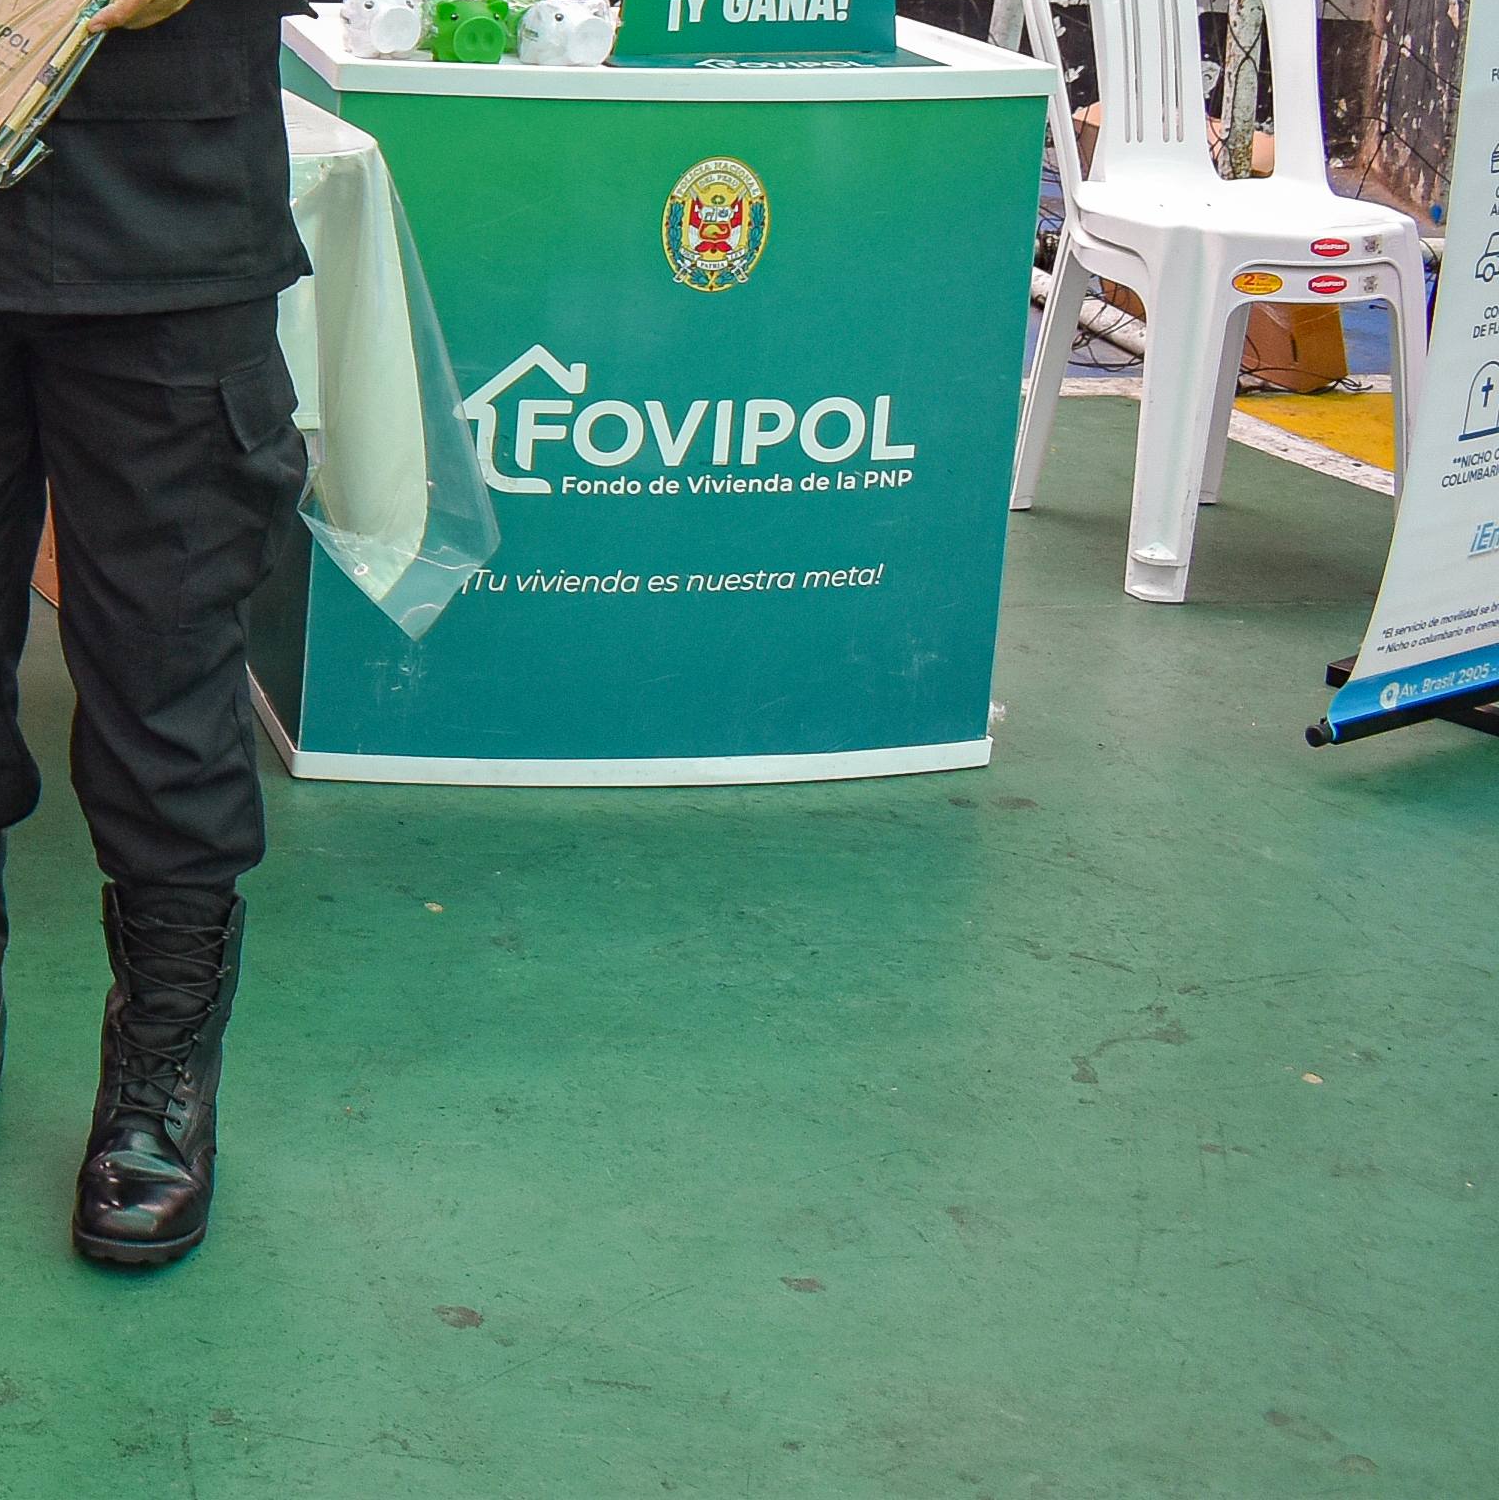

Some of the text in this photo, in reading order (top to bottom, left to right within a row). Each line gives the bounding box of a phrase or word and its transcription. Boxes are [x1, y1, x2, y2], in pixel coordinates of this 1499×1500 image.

[1243, 273, 1255, 287] 2
[1472, 324, 1488, 339] DE
[515, 395, 916, 471] FOVIPOL
[561, 467, 914, 495] Fondo de Vivienda de la PNP
[460, 563, 885, 595] ¡Tu vivienda es nuestra meta!
[1394, 619, 1427, 636] servicio
[1428, 616, 1439, 628] de
[1441, 605, 1480, 625] movilidad
[1480, 605, 1490, 615] se
[1385, 624, 1475, 654] Nicho o columbario en
[1399, 662, 1491, 699] Av. Brasil 2905
